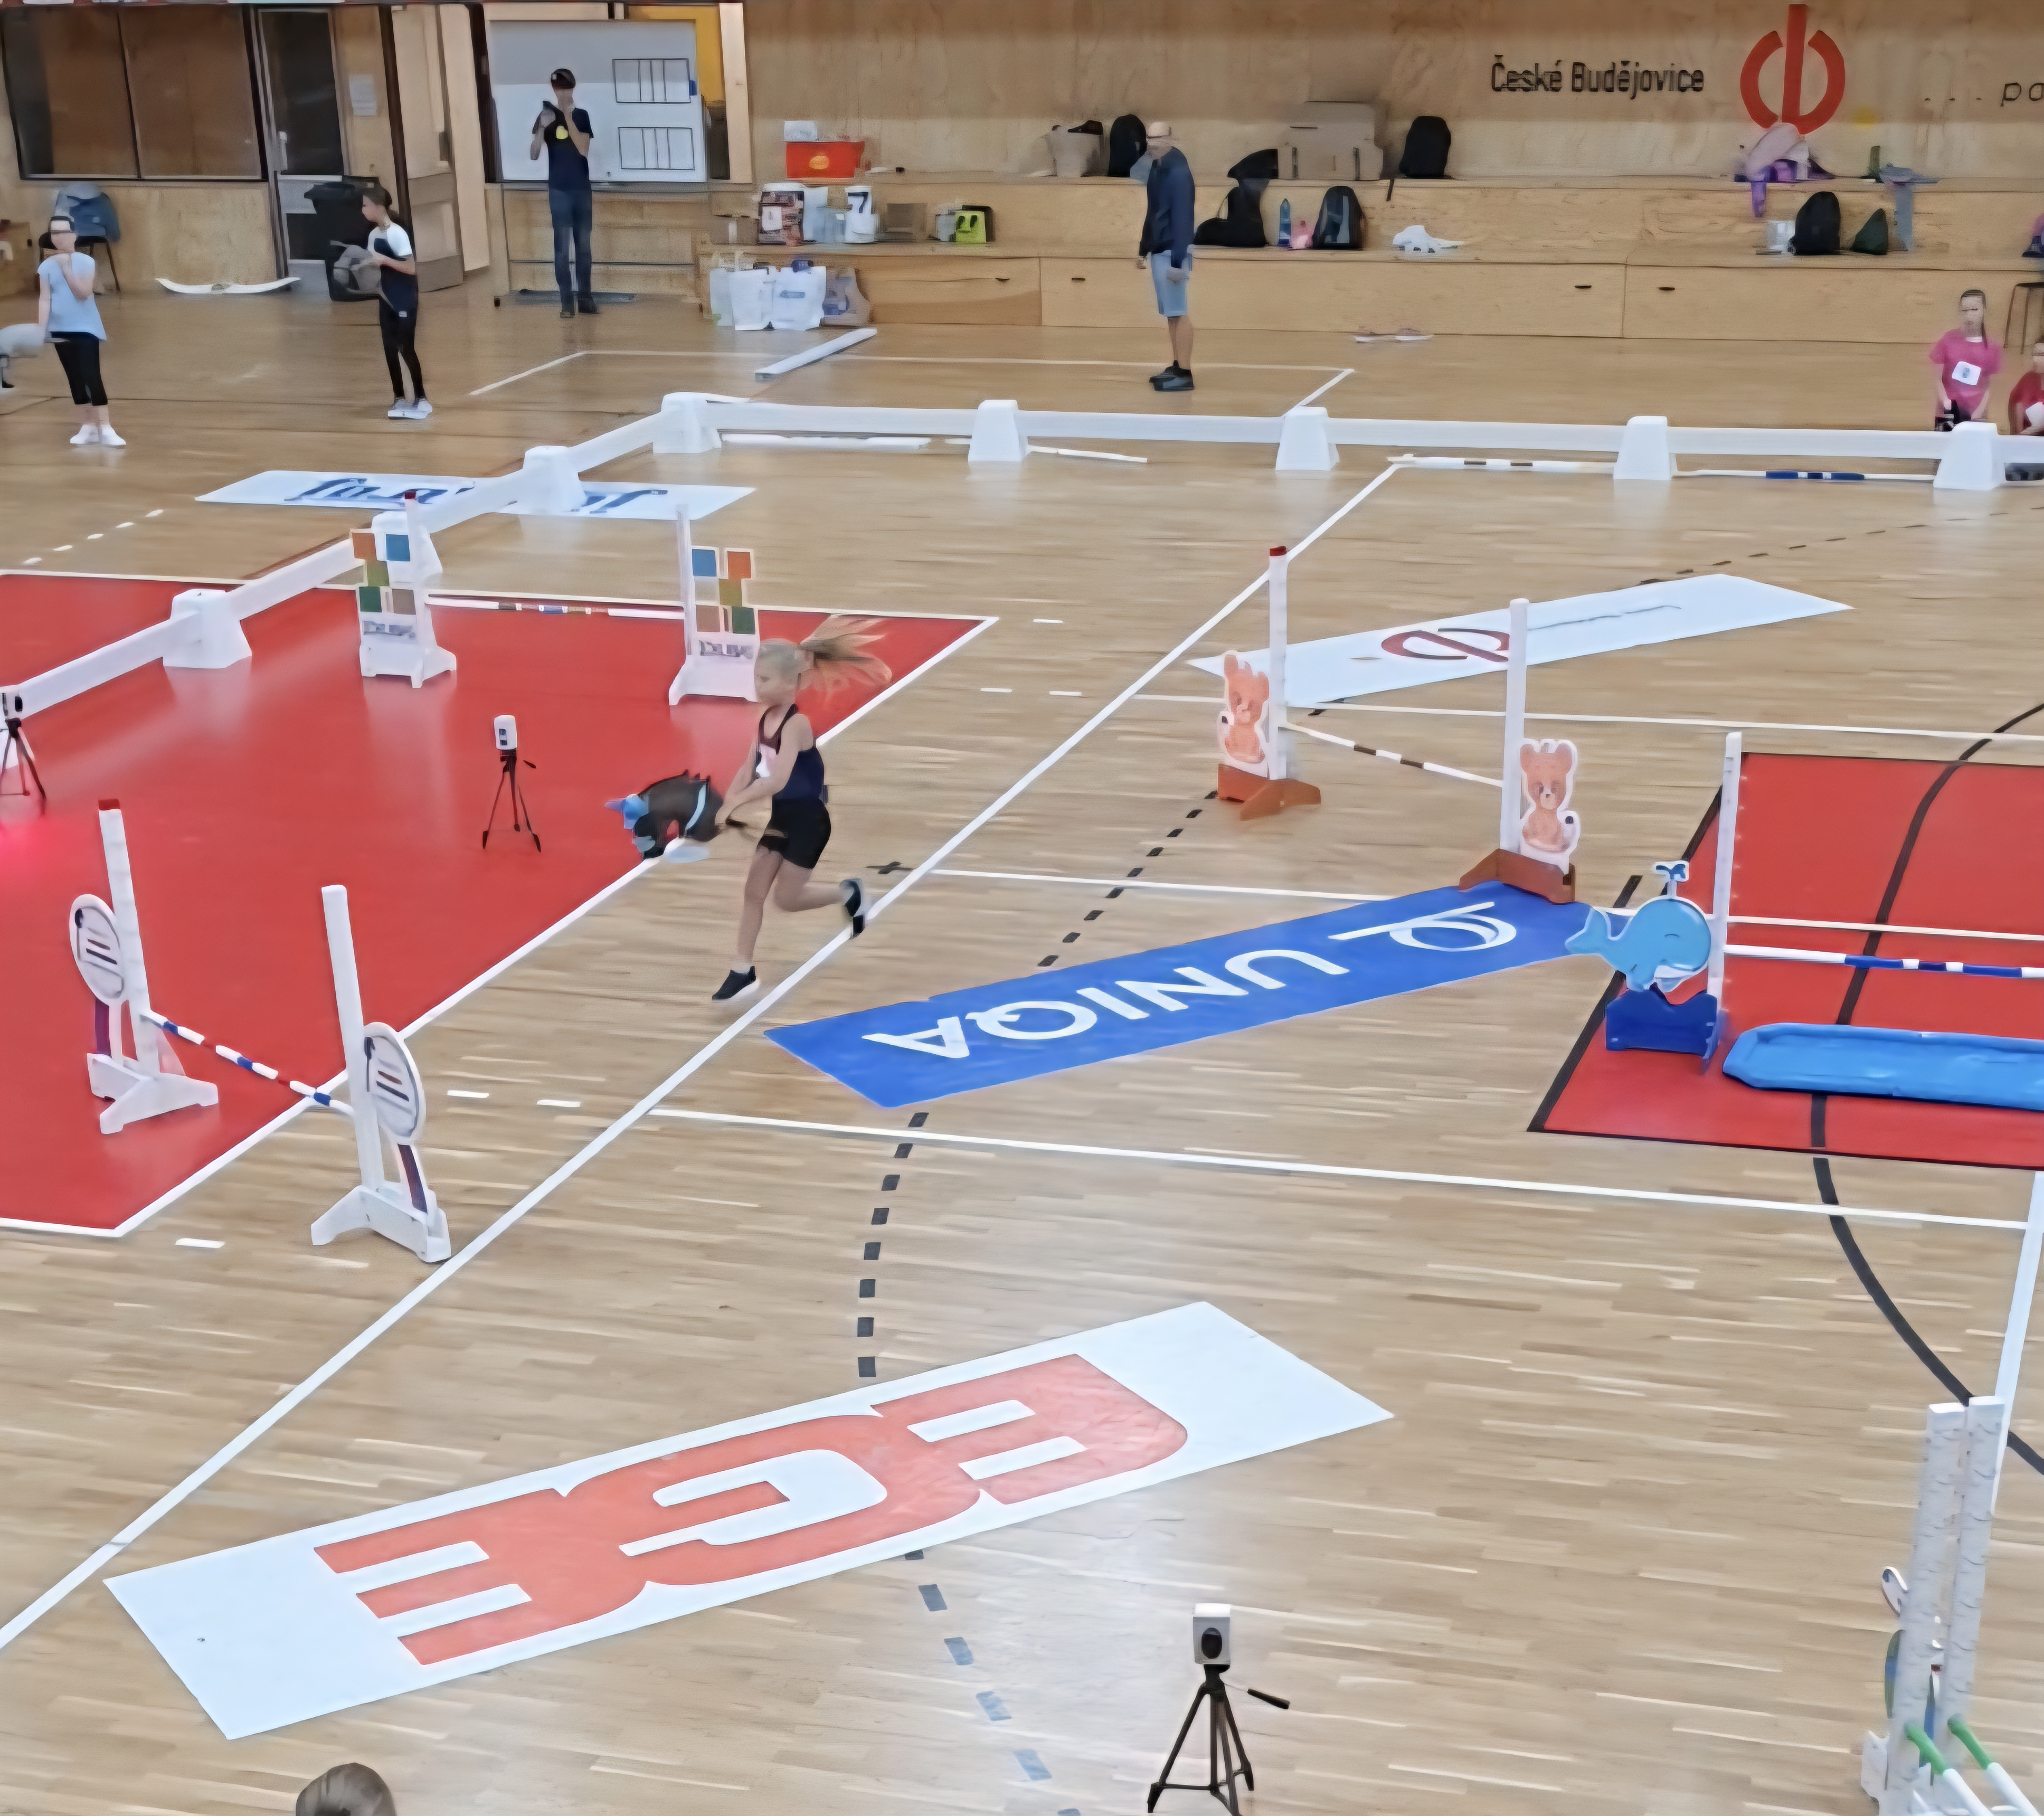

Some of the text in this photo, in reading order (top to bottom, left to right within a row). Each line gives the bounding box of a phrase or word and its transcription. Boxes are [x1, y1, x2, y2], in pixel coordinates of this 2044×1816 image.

[1491, 54, 1705, 100] České Budějovice
[862, 949, 1349, 1058] UNIQA
[314, 1353, 1188, 1666] EGE
